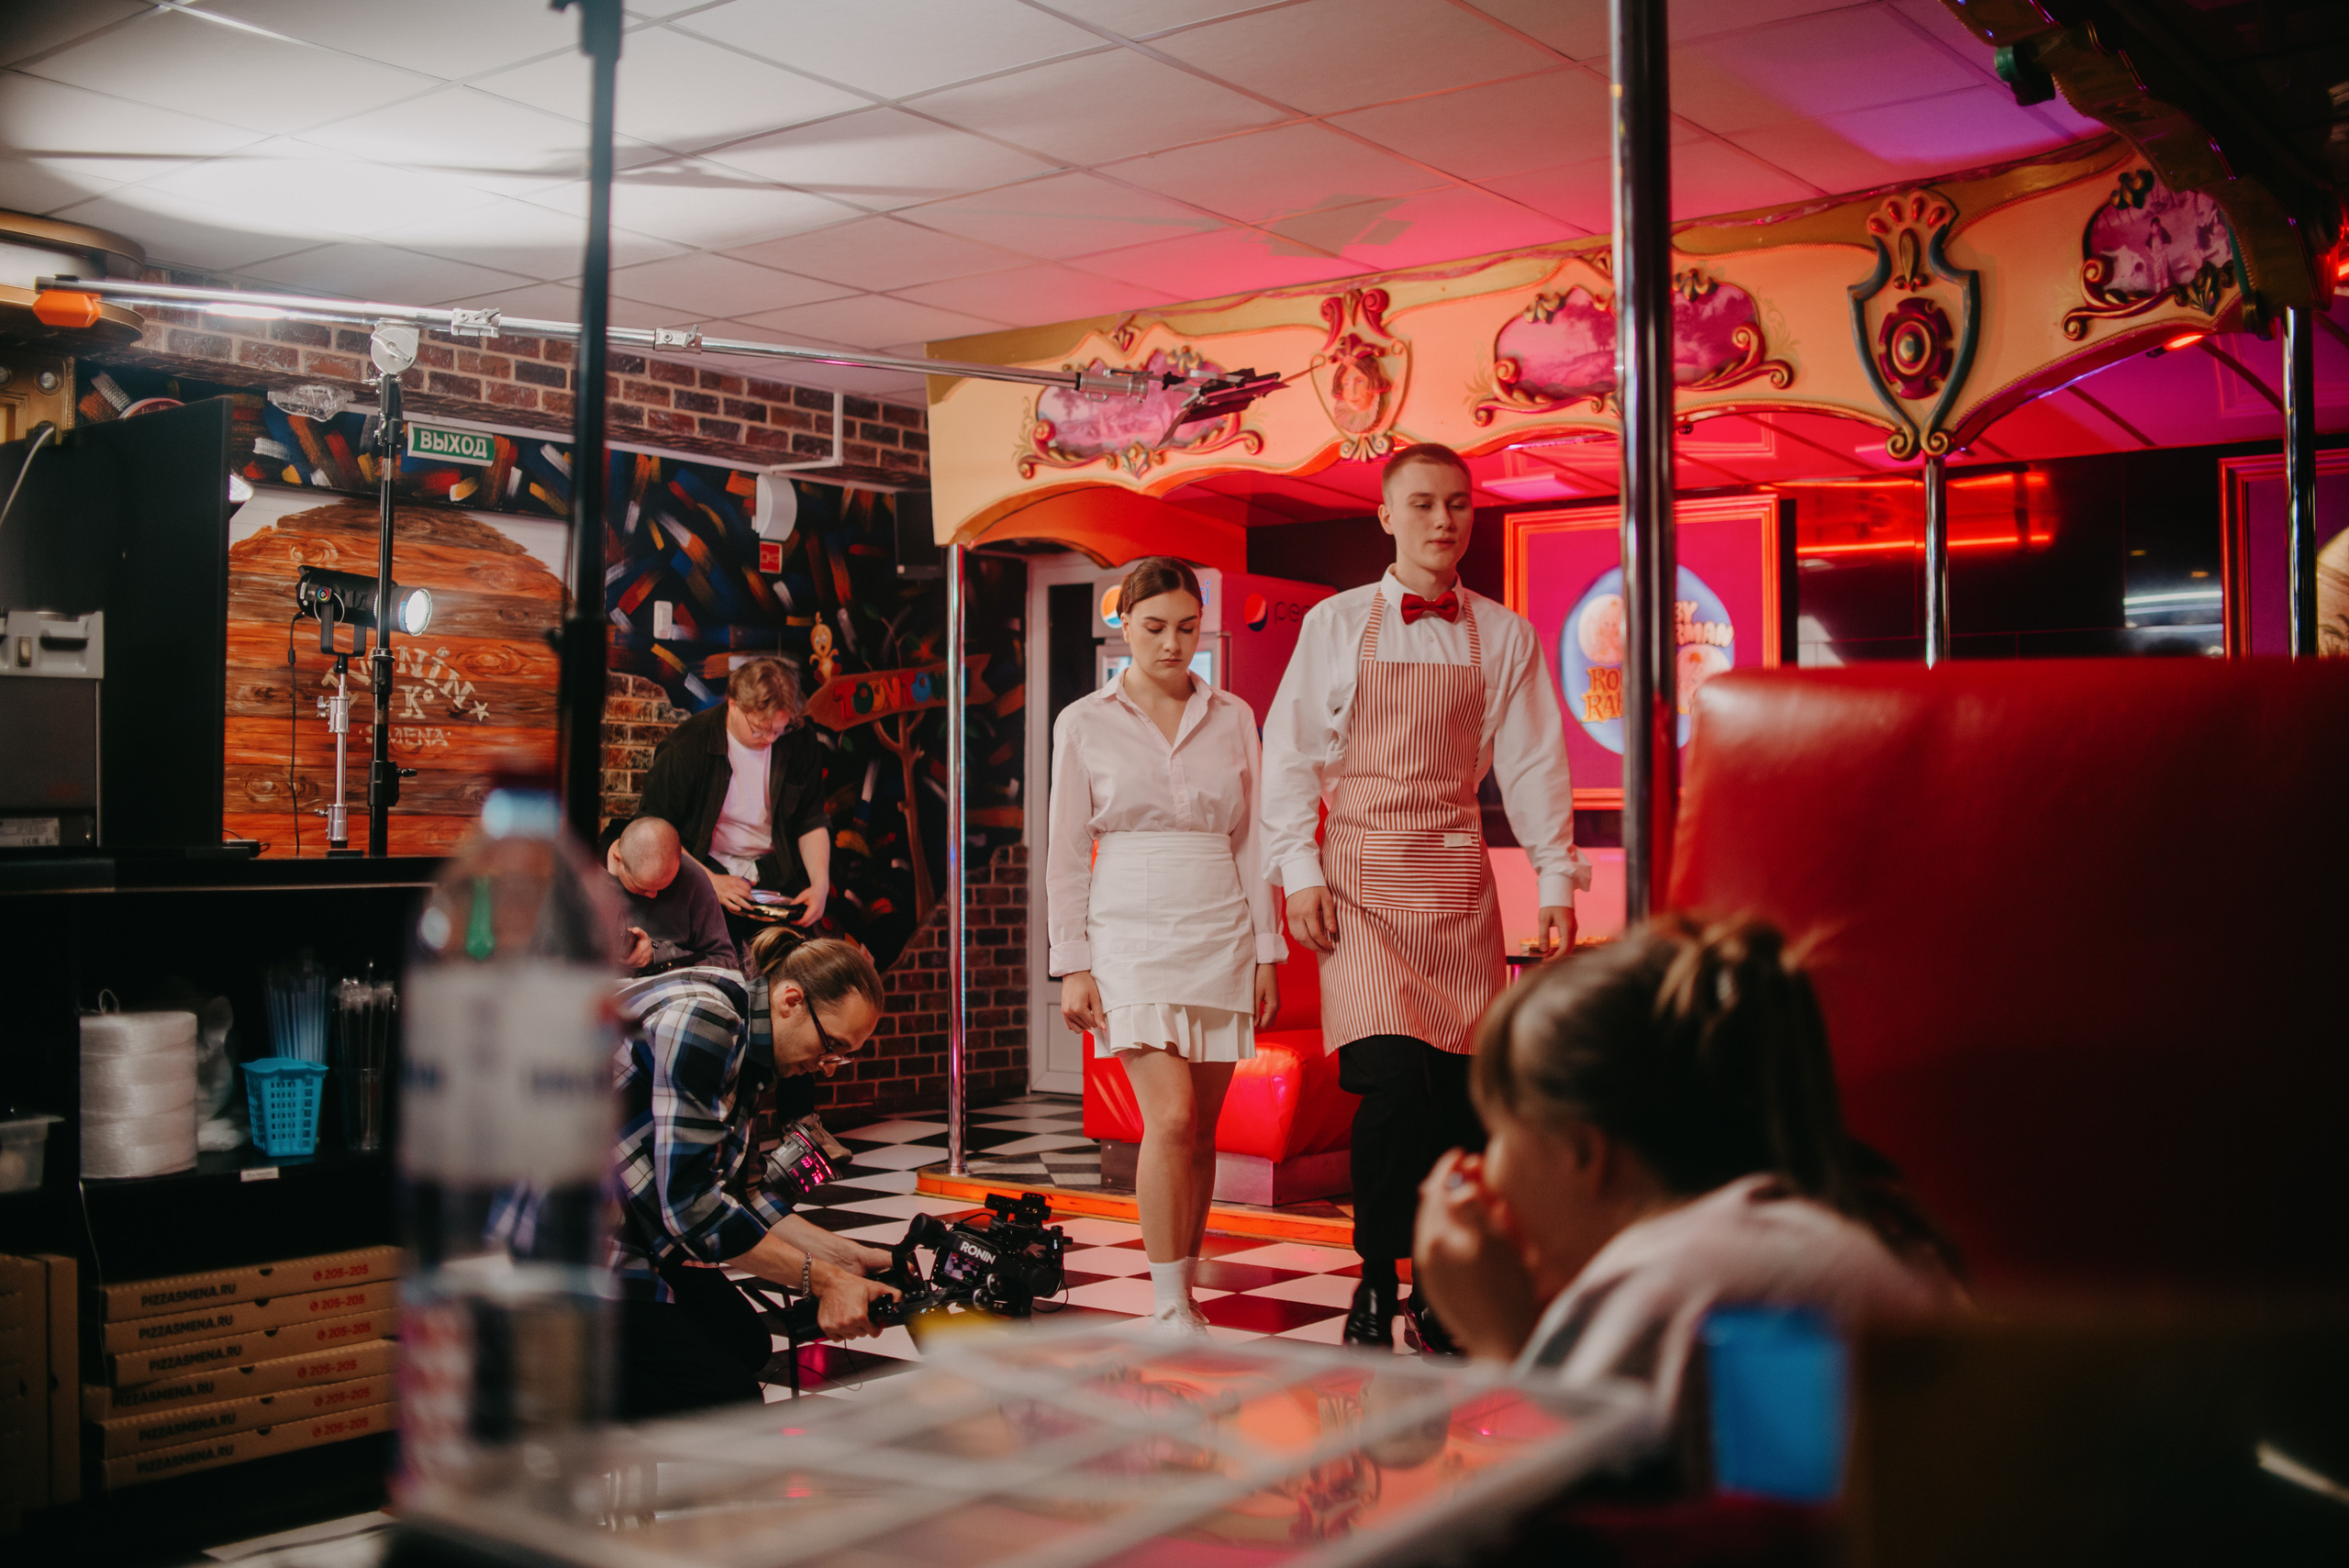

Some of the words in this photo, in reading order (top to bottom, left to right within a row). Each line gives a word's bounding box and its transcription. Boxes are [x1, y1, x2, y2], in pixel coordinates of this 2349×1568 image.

[419, 429, 488, 459] ВЫХОД
[834, 668, 971, 721] TOONTOW
[960, 1240, 996, 1265] RONIN
[141, 1284, 236, 1307] PIZZASMENA.RU
[325, 1264, 368, 1279] 205-205
[139, 1314, 233, 1340] PIZZASMENA.RU
[321, 1294, 365, 1310] 205-205
[149, 1345, 242, 1373] PIZZASMENA.RU
[328, 1323, 371, 1340] 205-205
[309, 1360, 357, 1376] 205-205
[139, 1413, 236, 1441] PIZZASMENA.RU
[325, 1388, 370, 1405] 205-205
[137, 1444, 234, 1473] PIZZASMENA.RU
[323, 1418, 368, 1435] 205-205
